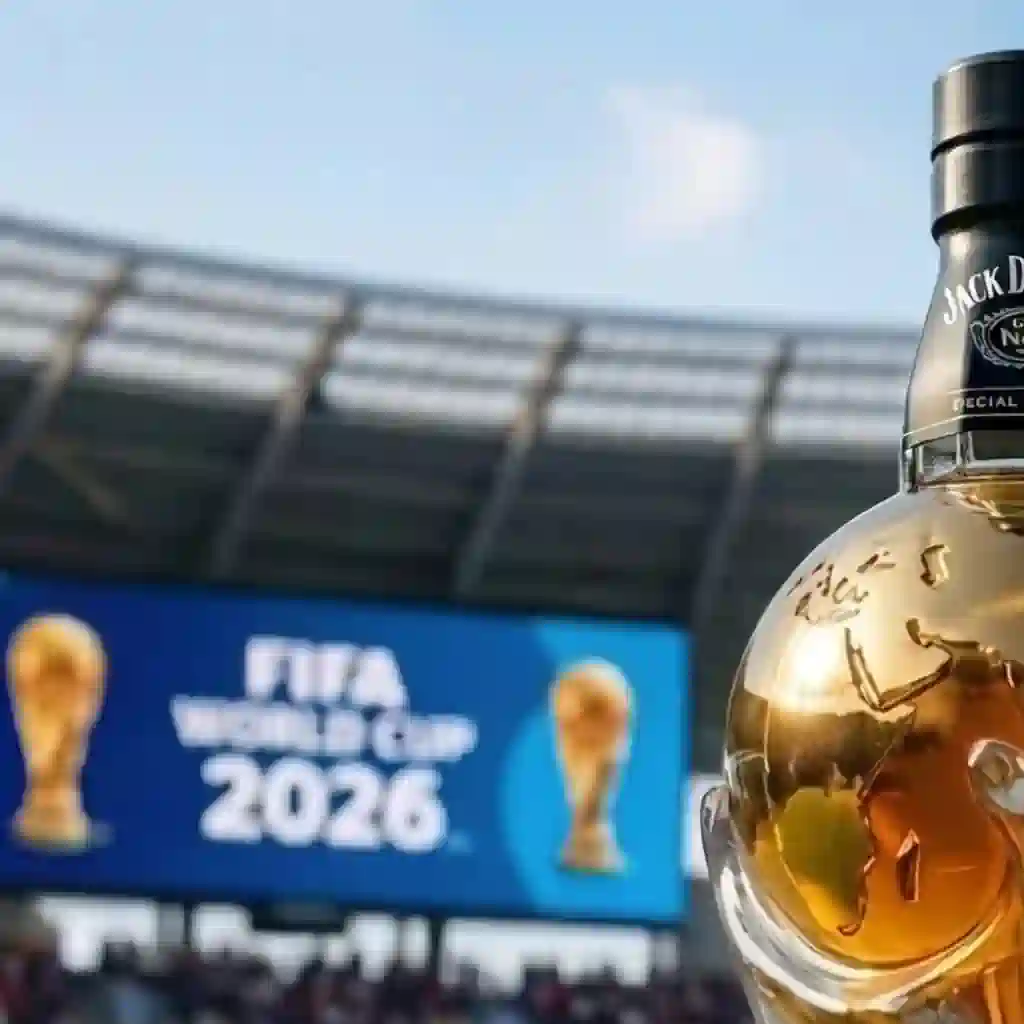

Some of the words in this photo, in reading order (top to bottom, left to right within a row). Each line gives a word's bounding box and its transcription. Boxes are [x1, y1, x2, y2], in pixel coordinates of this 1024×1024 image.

[943, 265, 1004, 325] JACK
[951, 395, 1018, 412] PECIAL
[244, 636, 408, 707] FIFA
[170, 695, 367, 756] WORLD
[371, 703, 478, 763] CUP
[200, 754, 448, 853] 2026
